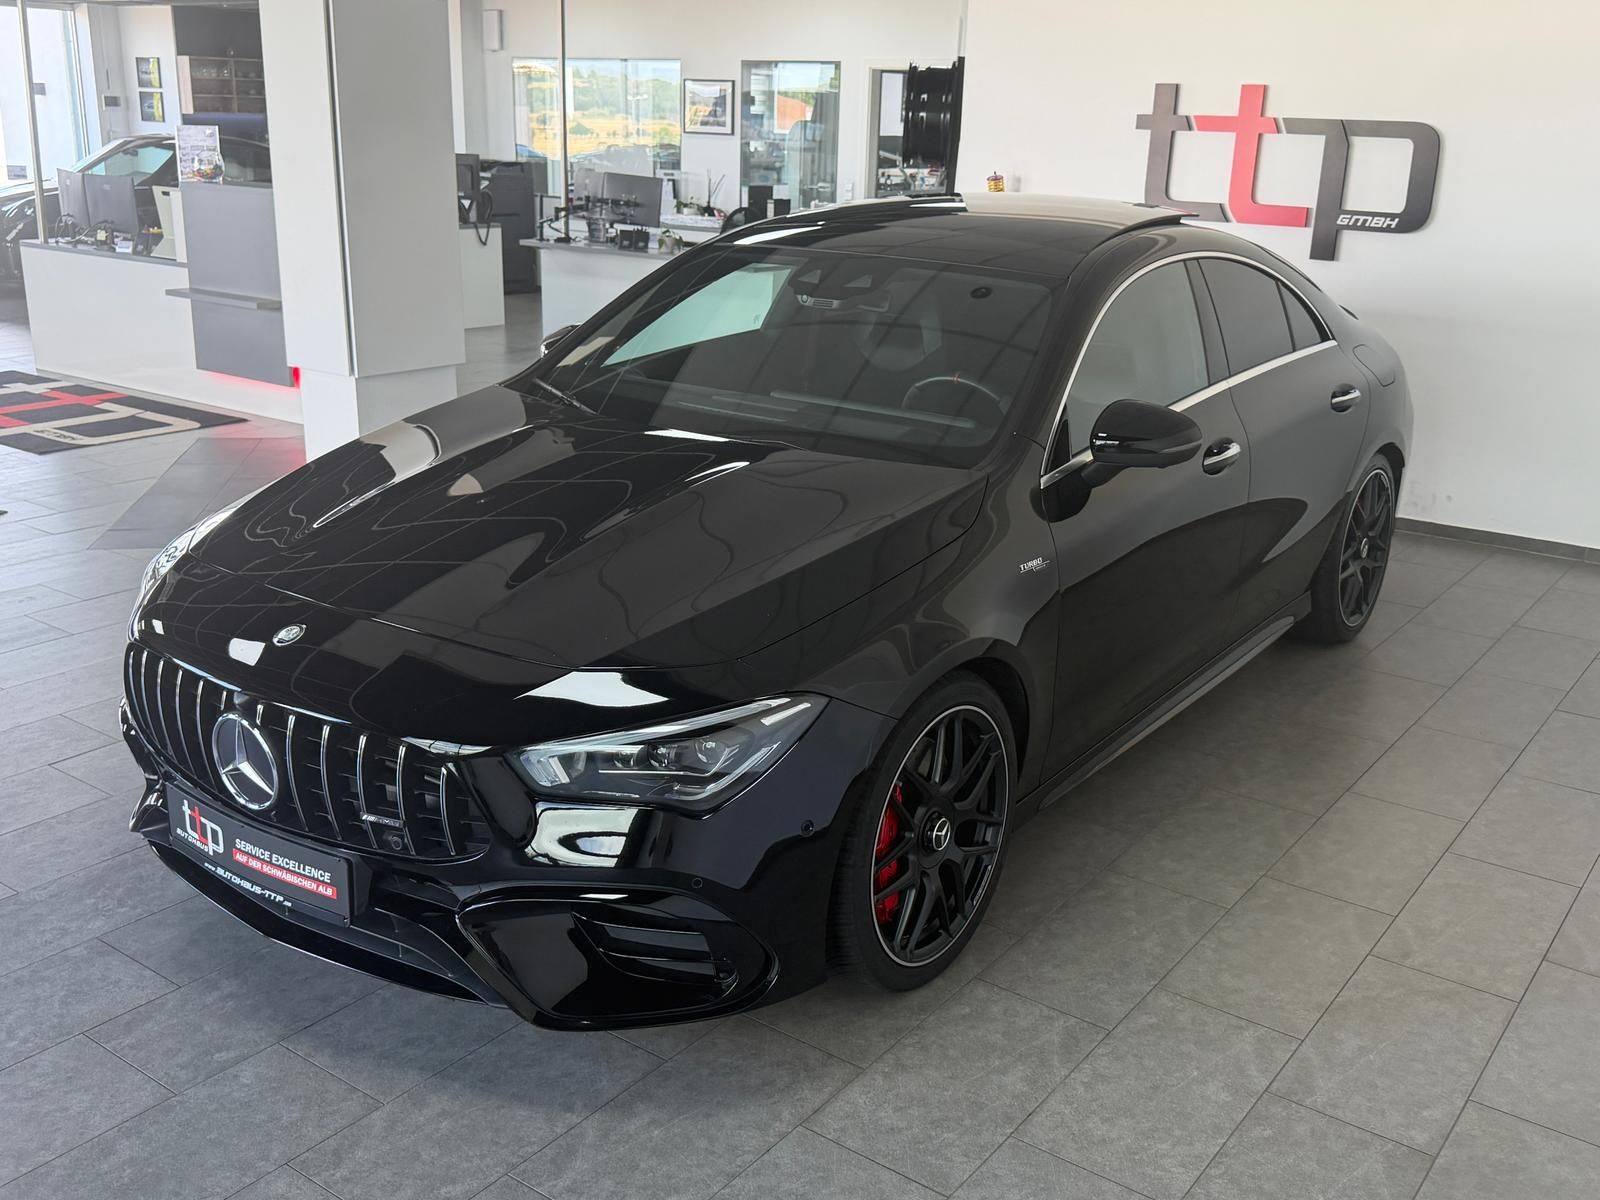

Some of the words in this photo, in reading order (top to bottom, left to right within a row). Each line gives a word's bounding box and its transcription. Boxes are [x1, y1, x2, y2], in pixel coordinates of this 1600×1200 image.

[1135, 83, 1440, 260] ttp
[1019, 557, 1043, 571] TURBO
[234, 838, 271, 862] SERVICE
[271, 853, 332, 883] EXCELLENCE
[235, 852, 249, 864] AUF
[248, 858, 262, 871] DER
[262, 864, 317, 892] SCHWÄBISCHEN
[317, 884, 333, 896] ALB
